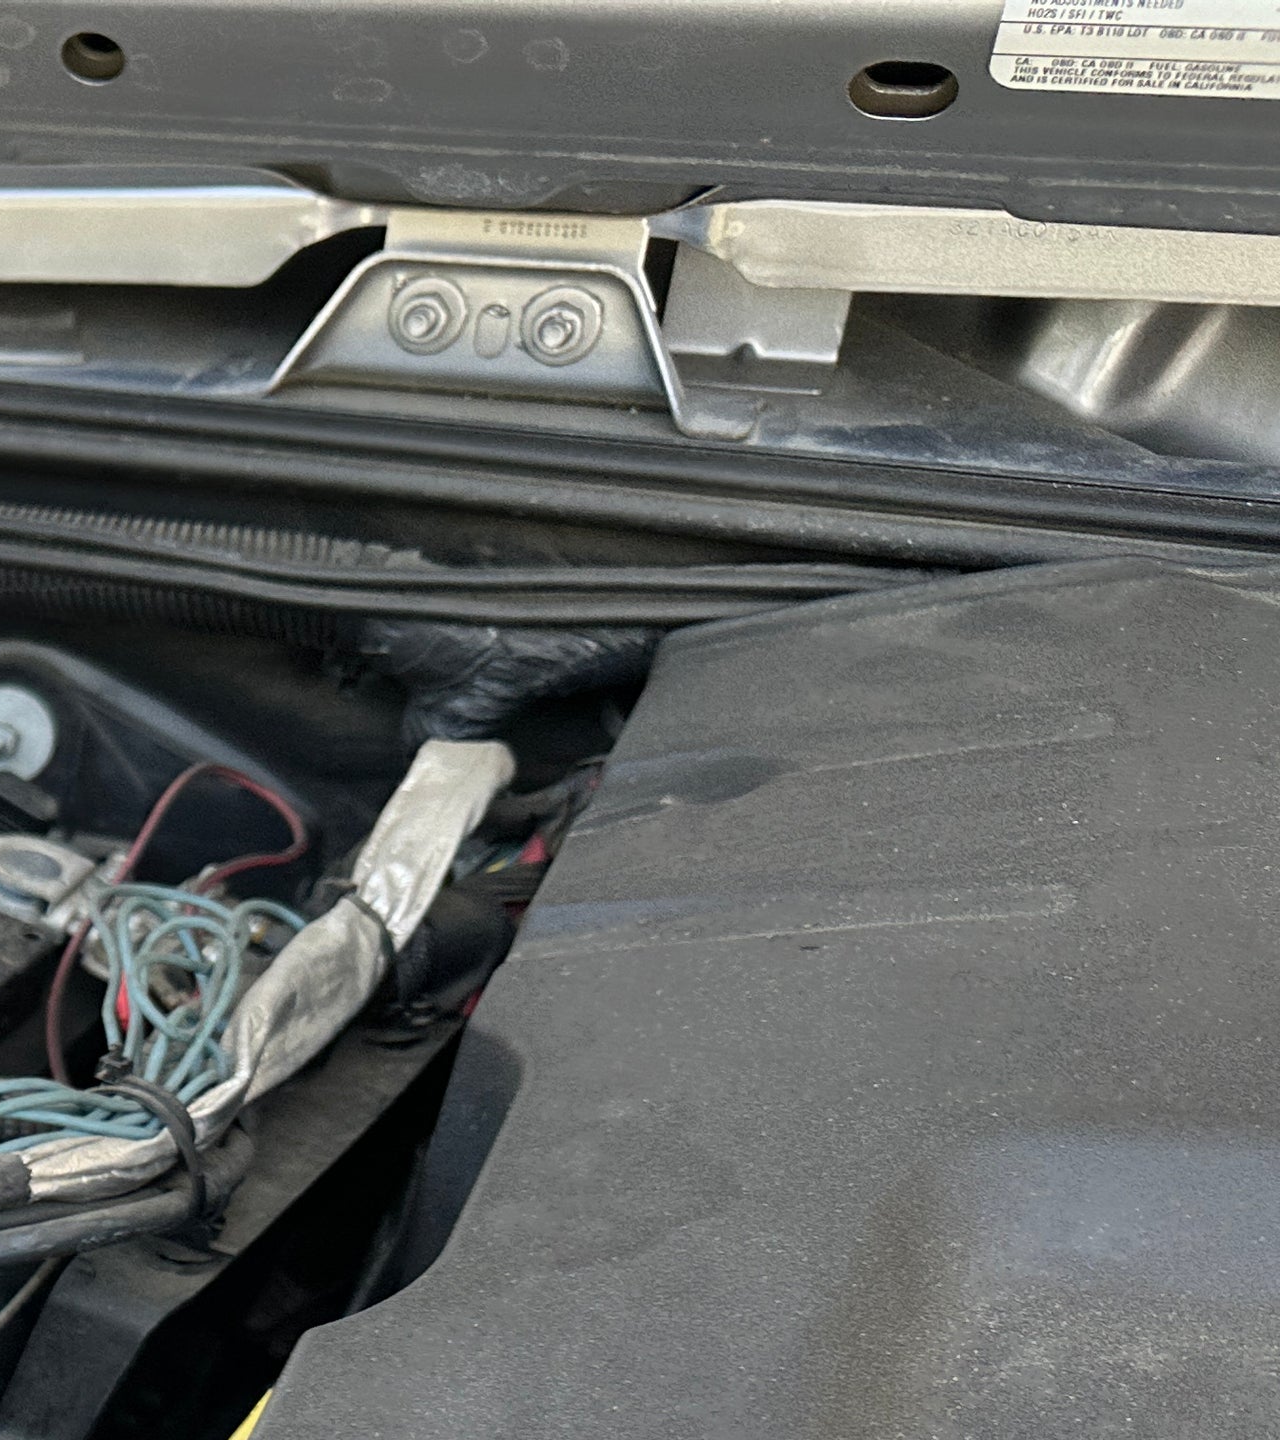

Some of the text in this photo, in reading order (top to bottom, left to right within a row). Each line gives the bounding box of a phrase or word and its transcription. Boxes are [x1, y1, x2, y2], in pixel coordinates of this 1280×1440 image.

[1137, 0, 1185, 9] NEEDED
[1068, 9, 1087, 20] SFI
[1098, 10, 1125, 21] TWC
[1023, 24, 1046, 35] U.S.
[1190, 30, 1206, 40] CA
[1081, 59, 1096, 68] CA
[1013, 66, 1040, 75] THIS
[1043, 67, 1088, 77] VEHICLE
[1091, 69, 1154, 79] CONFORMS
[1157, 71, 1173, 80] TO
[1175, 72, 1225, 82] FEDERAL
[1010, 74, 1254, 92] AND IS CERTIFIED FOR SALE IN CALIFORNIA
